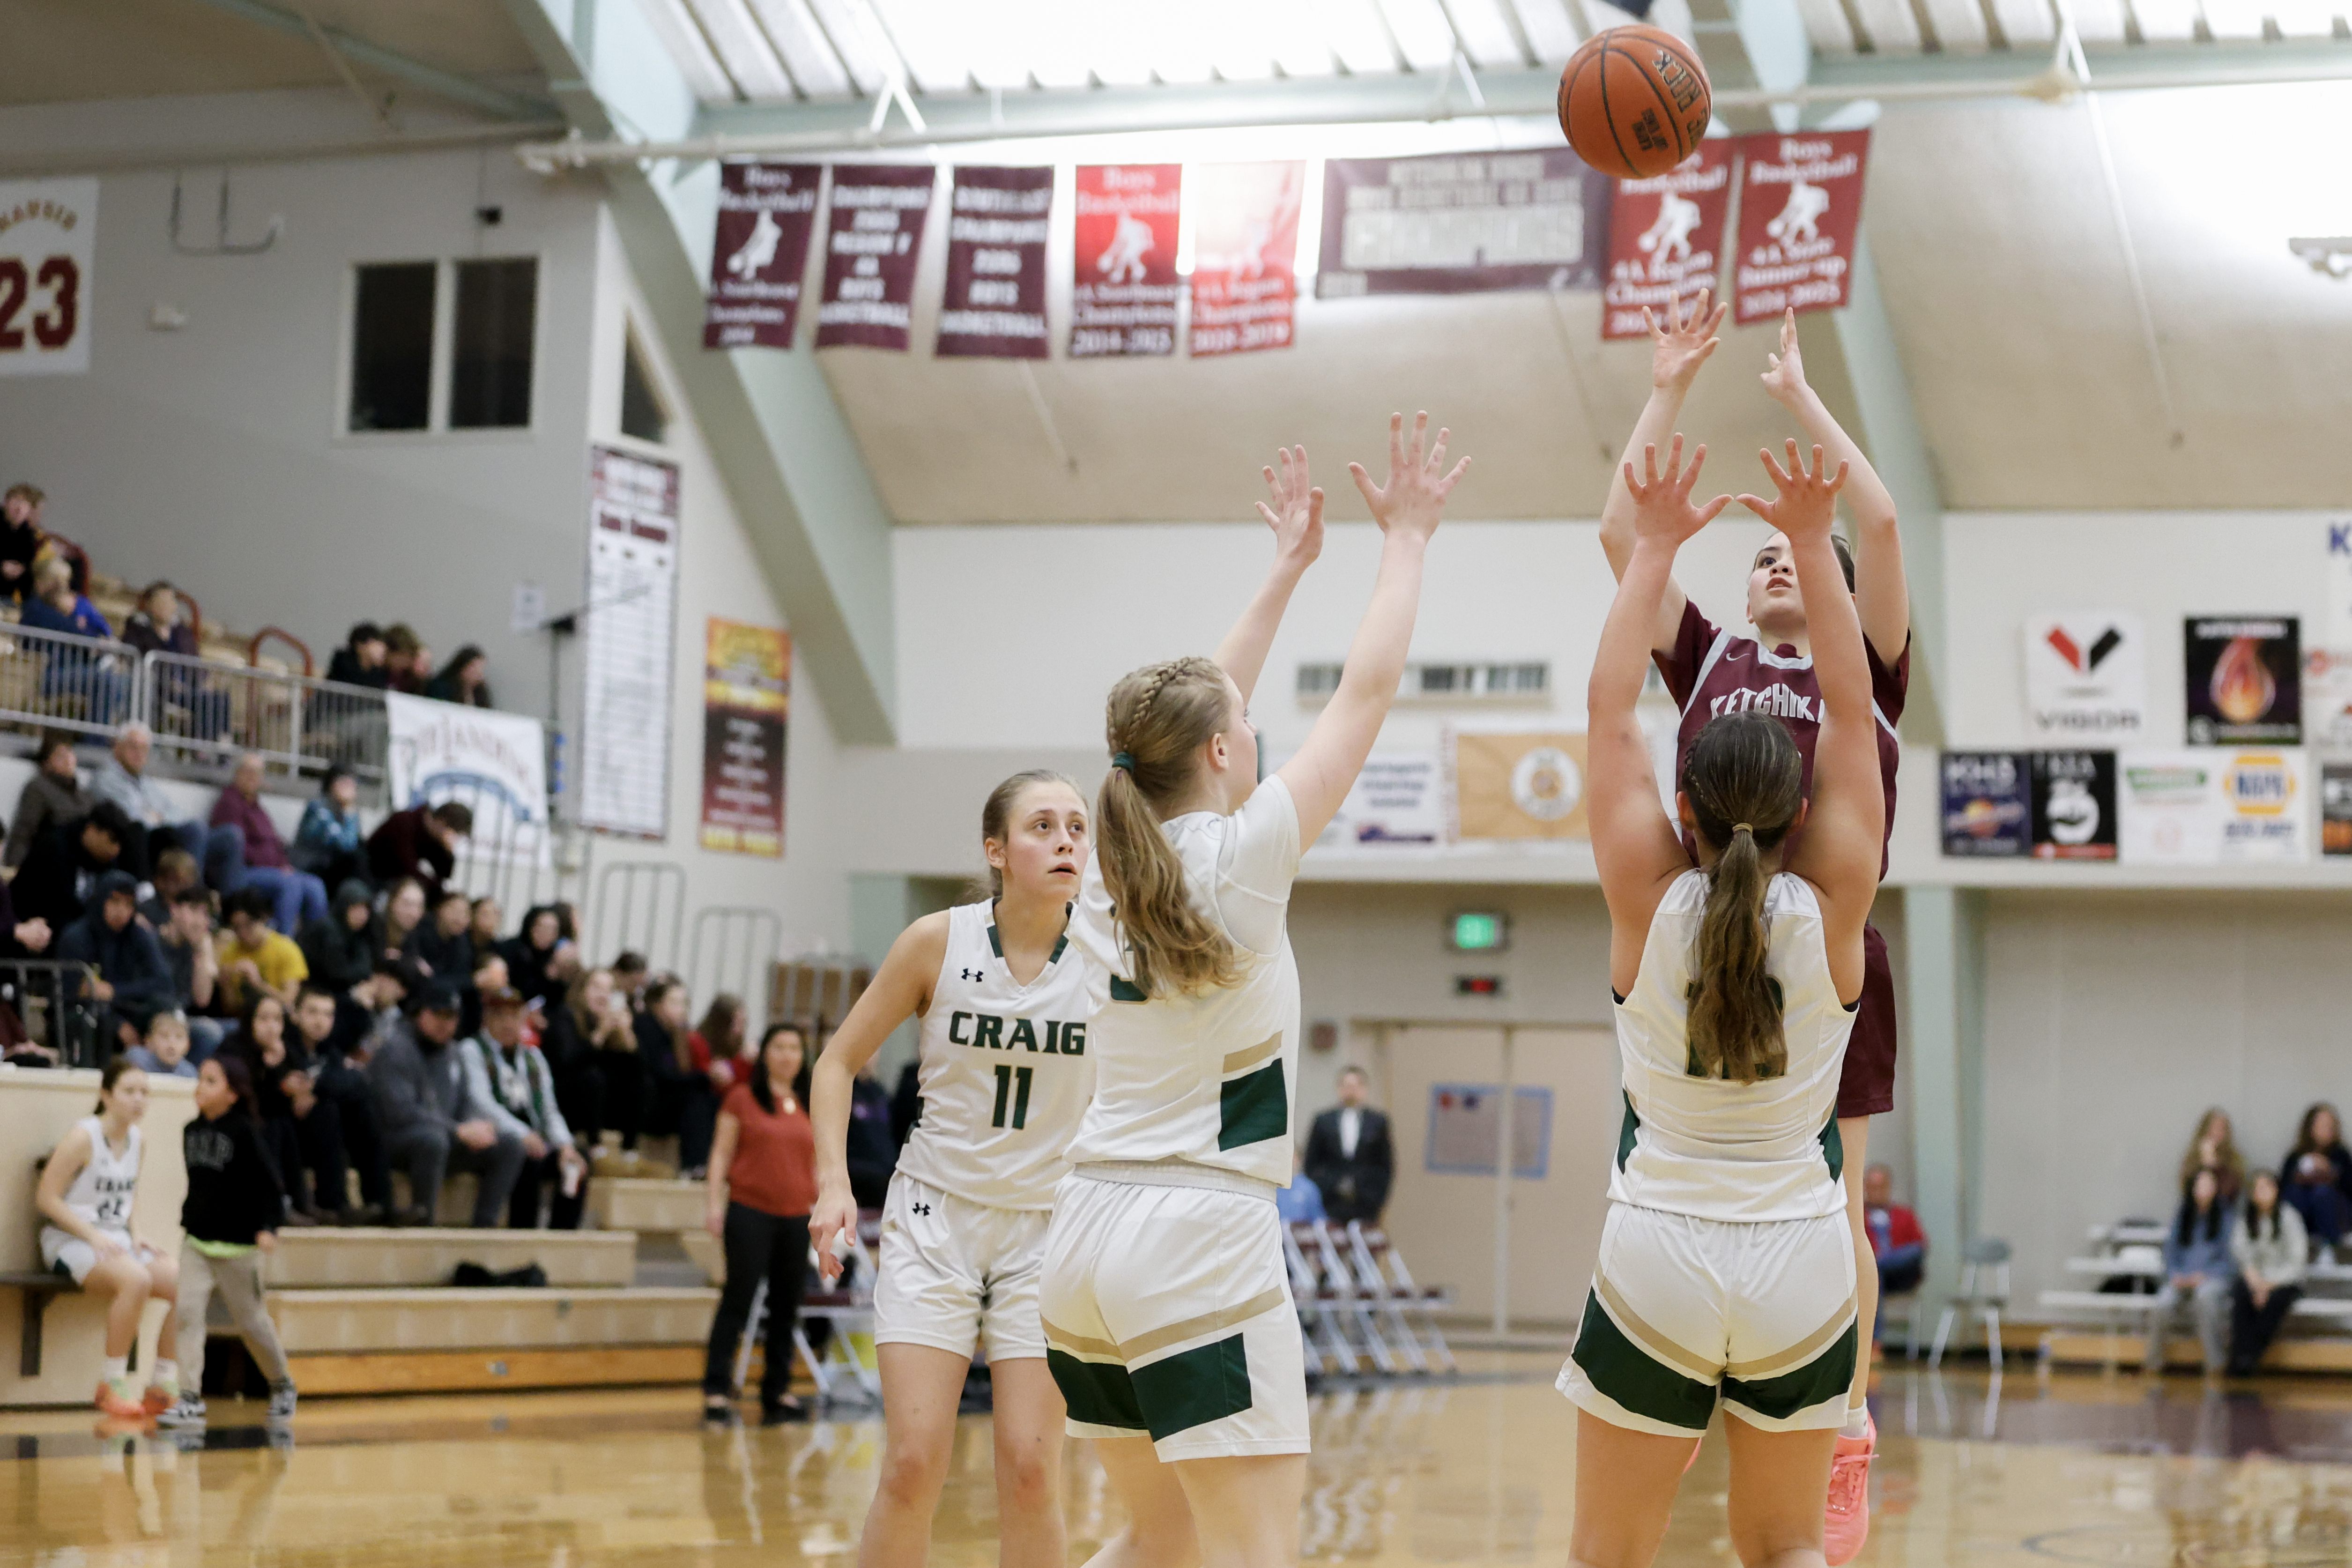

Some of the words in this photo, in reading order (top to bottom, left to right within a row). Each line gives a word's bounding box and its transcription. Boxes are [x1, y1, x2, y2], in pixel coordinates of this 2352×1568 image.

[0, 255, 79, 349] 23
[1710, 683, 1825, 724] KETCHIK
[949, 1011, 1086, 1056] CRAIG
[991, 1064, 1033, 1130] 11
